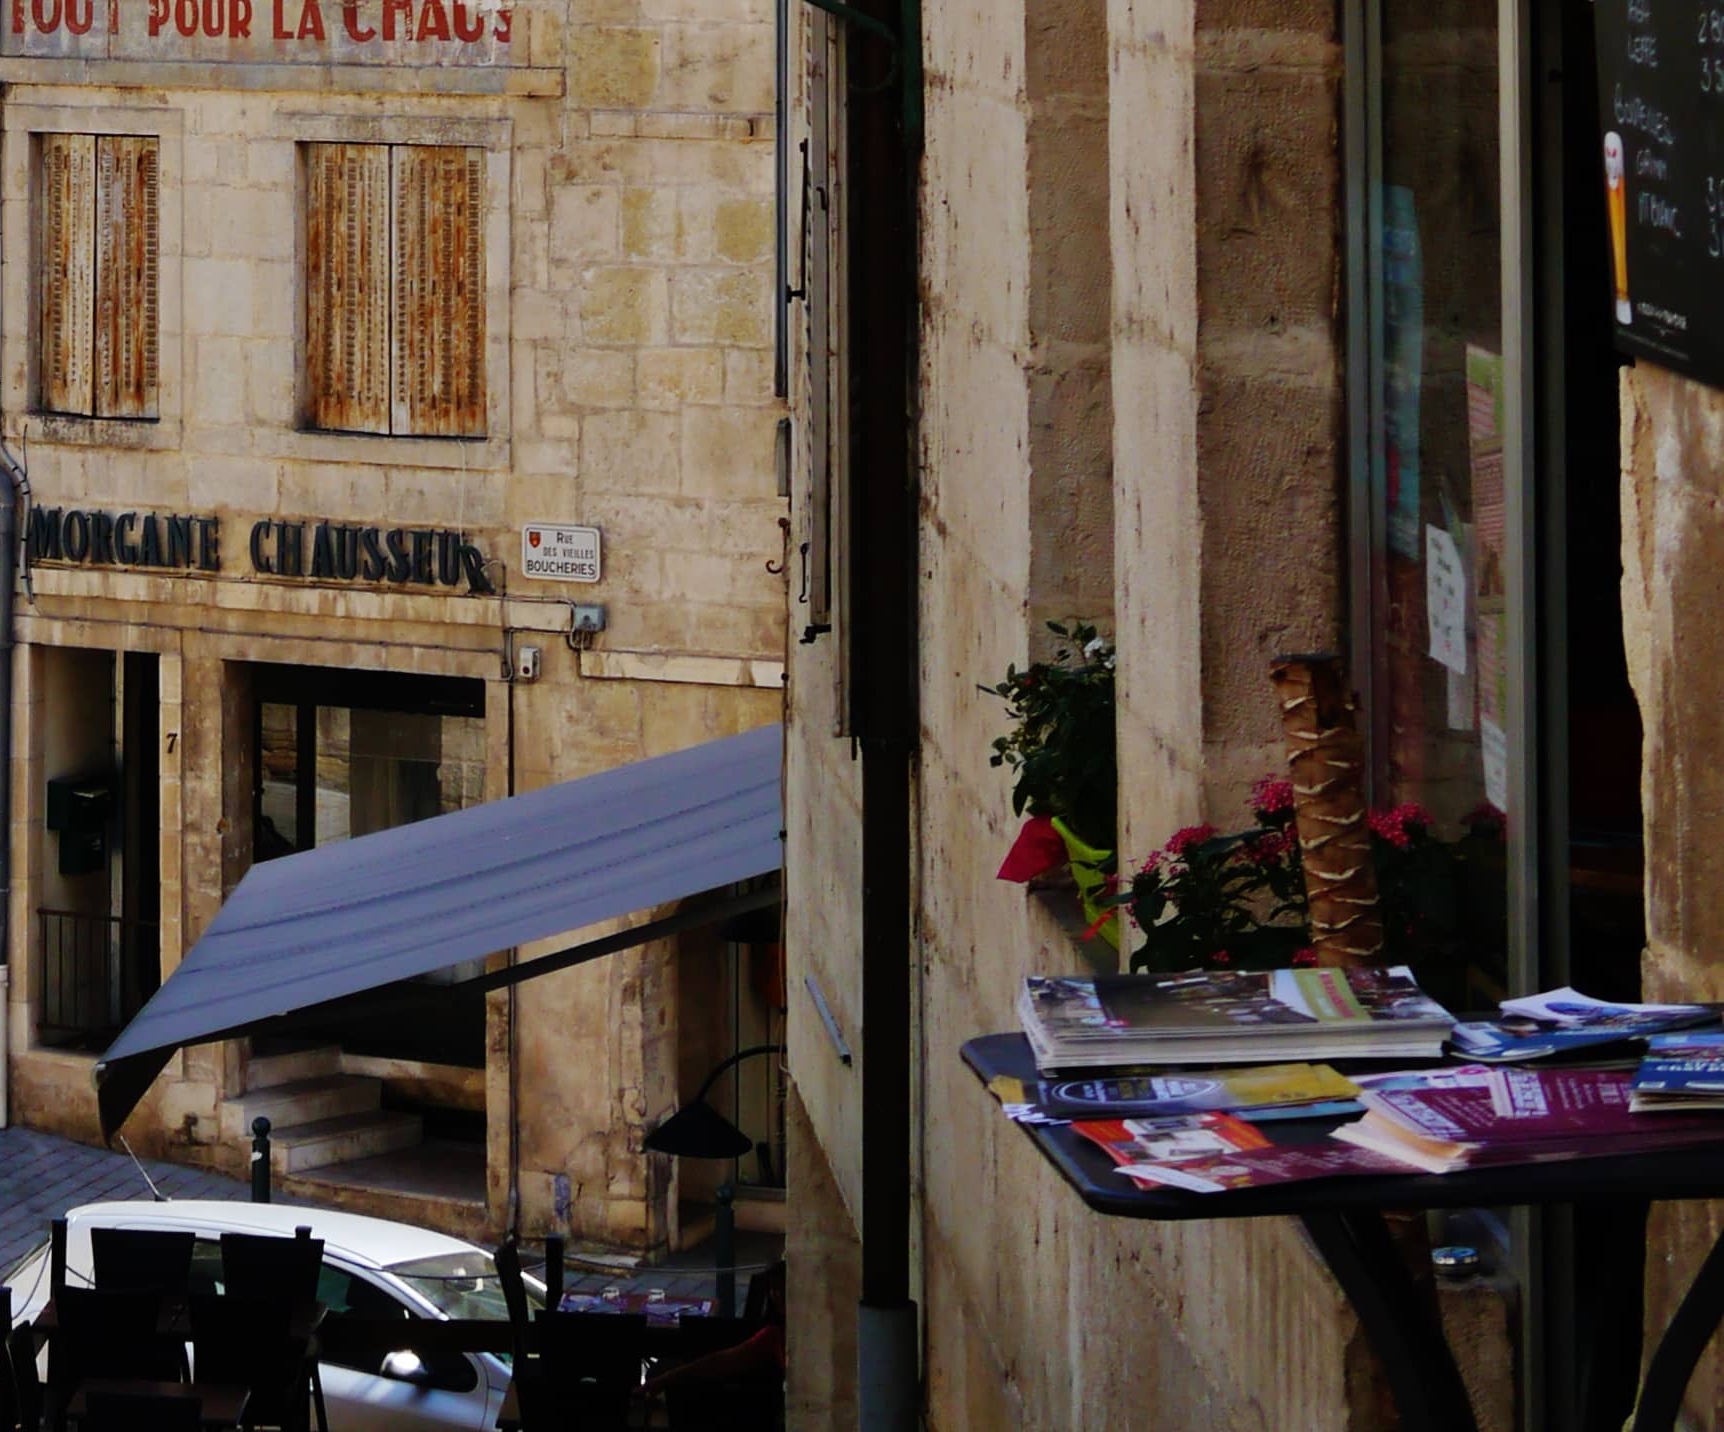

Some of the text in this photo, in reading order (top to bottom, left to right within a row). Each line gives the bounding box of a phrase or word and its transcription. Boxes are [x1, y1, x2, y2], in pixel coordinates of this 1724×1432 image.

[28, 504, 497, 596] MORGANE CHAUSSEUR
[527, 559, 596, 576] BOUCHERIES
[166, 732, 178, 754] 7
